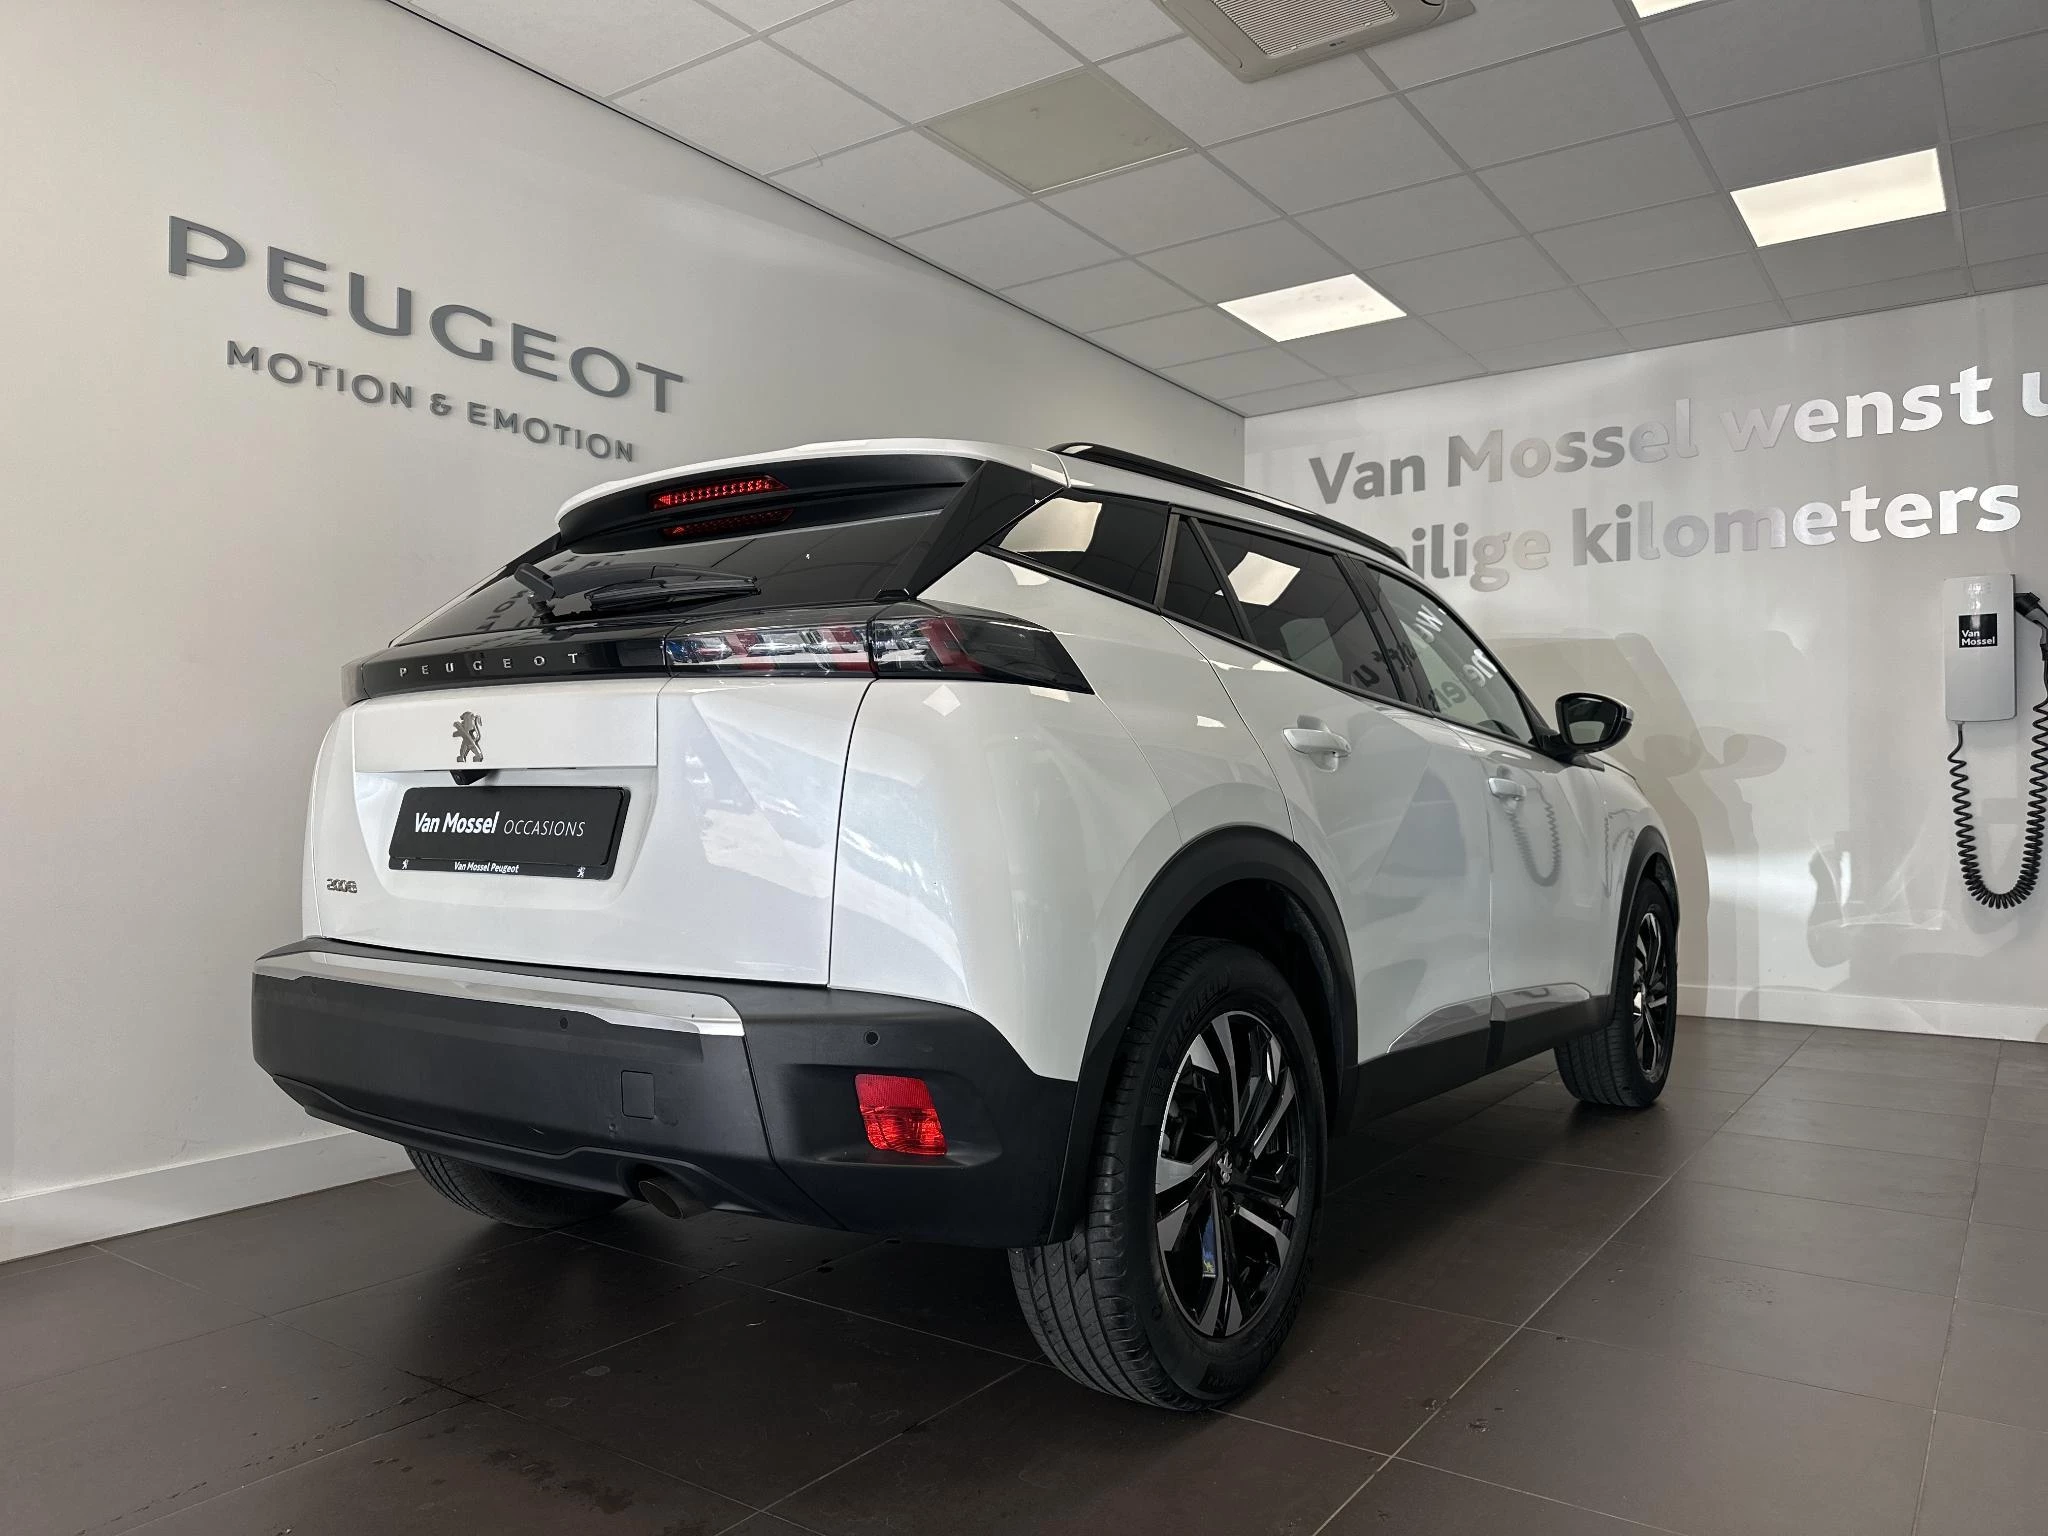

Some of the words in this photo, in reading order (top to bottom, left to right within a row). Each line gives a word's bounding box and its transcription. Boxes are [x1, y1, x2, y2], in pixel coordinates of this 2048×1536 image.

[168, 215, 684, 413] PEUGEOT
[226, 340, 413, 409] MOTION
[429, 392, 453, 417] &
[467, 401, 634, 463] EMOTION
[1308, 450, 1426, 506] Van
[1447, 398, 1701, 488] Mossel
[1718, 365, 1995, 454] wenst
[1571, 484, 2022, 567] kilometers
[398, 652, 579, 678] PEUGEOT
[1961, 636, 1996, 646] Mossel
[414, 812, 441, 833] Van
[442, 811, 500, 834] Mossel
[503, 819, 586, 837] OCCASIONS
[454, 861, 467, 871] Van
[467, 862, 491, 872] Mossel
[491, 863, 519, 874] Peugeot
